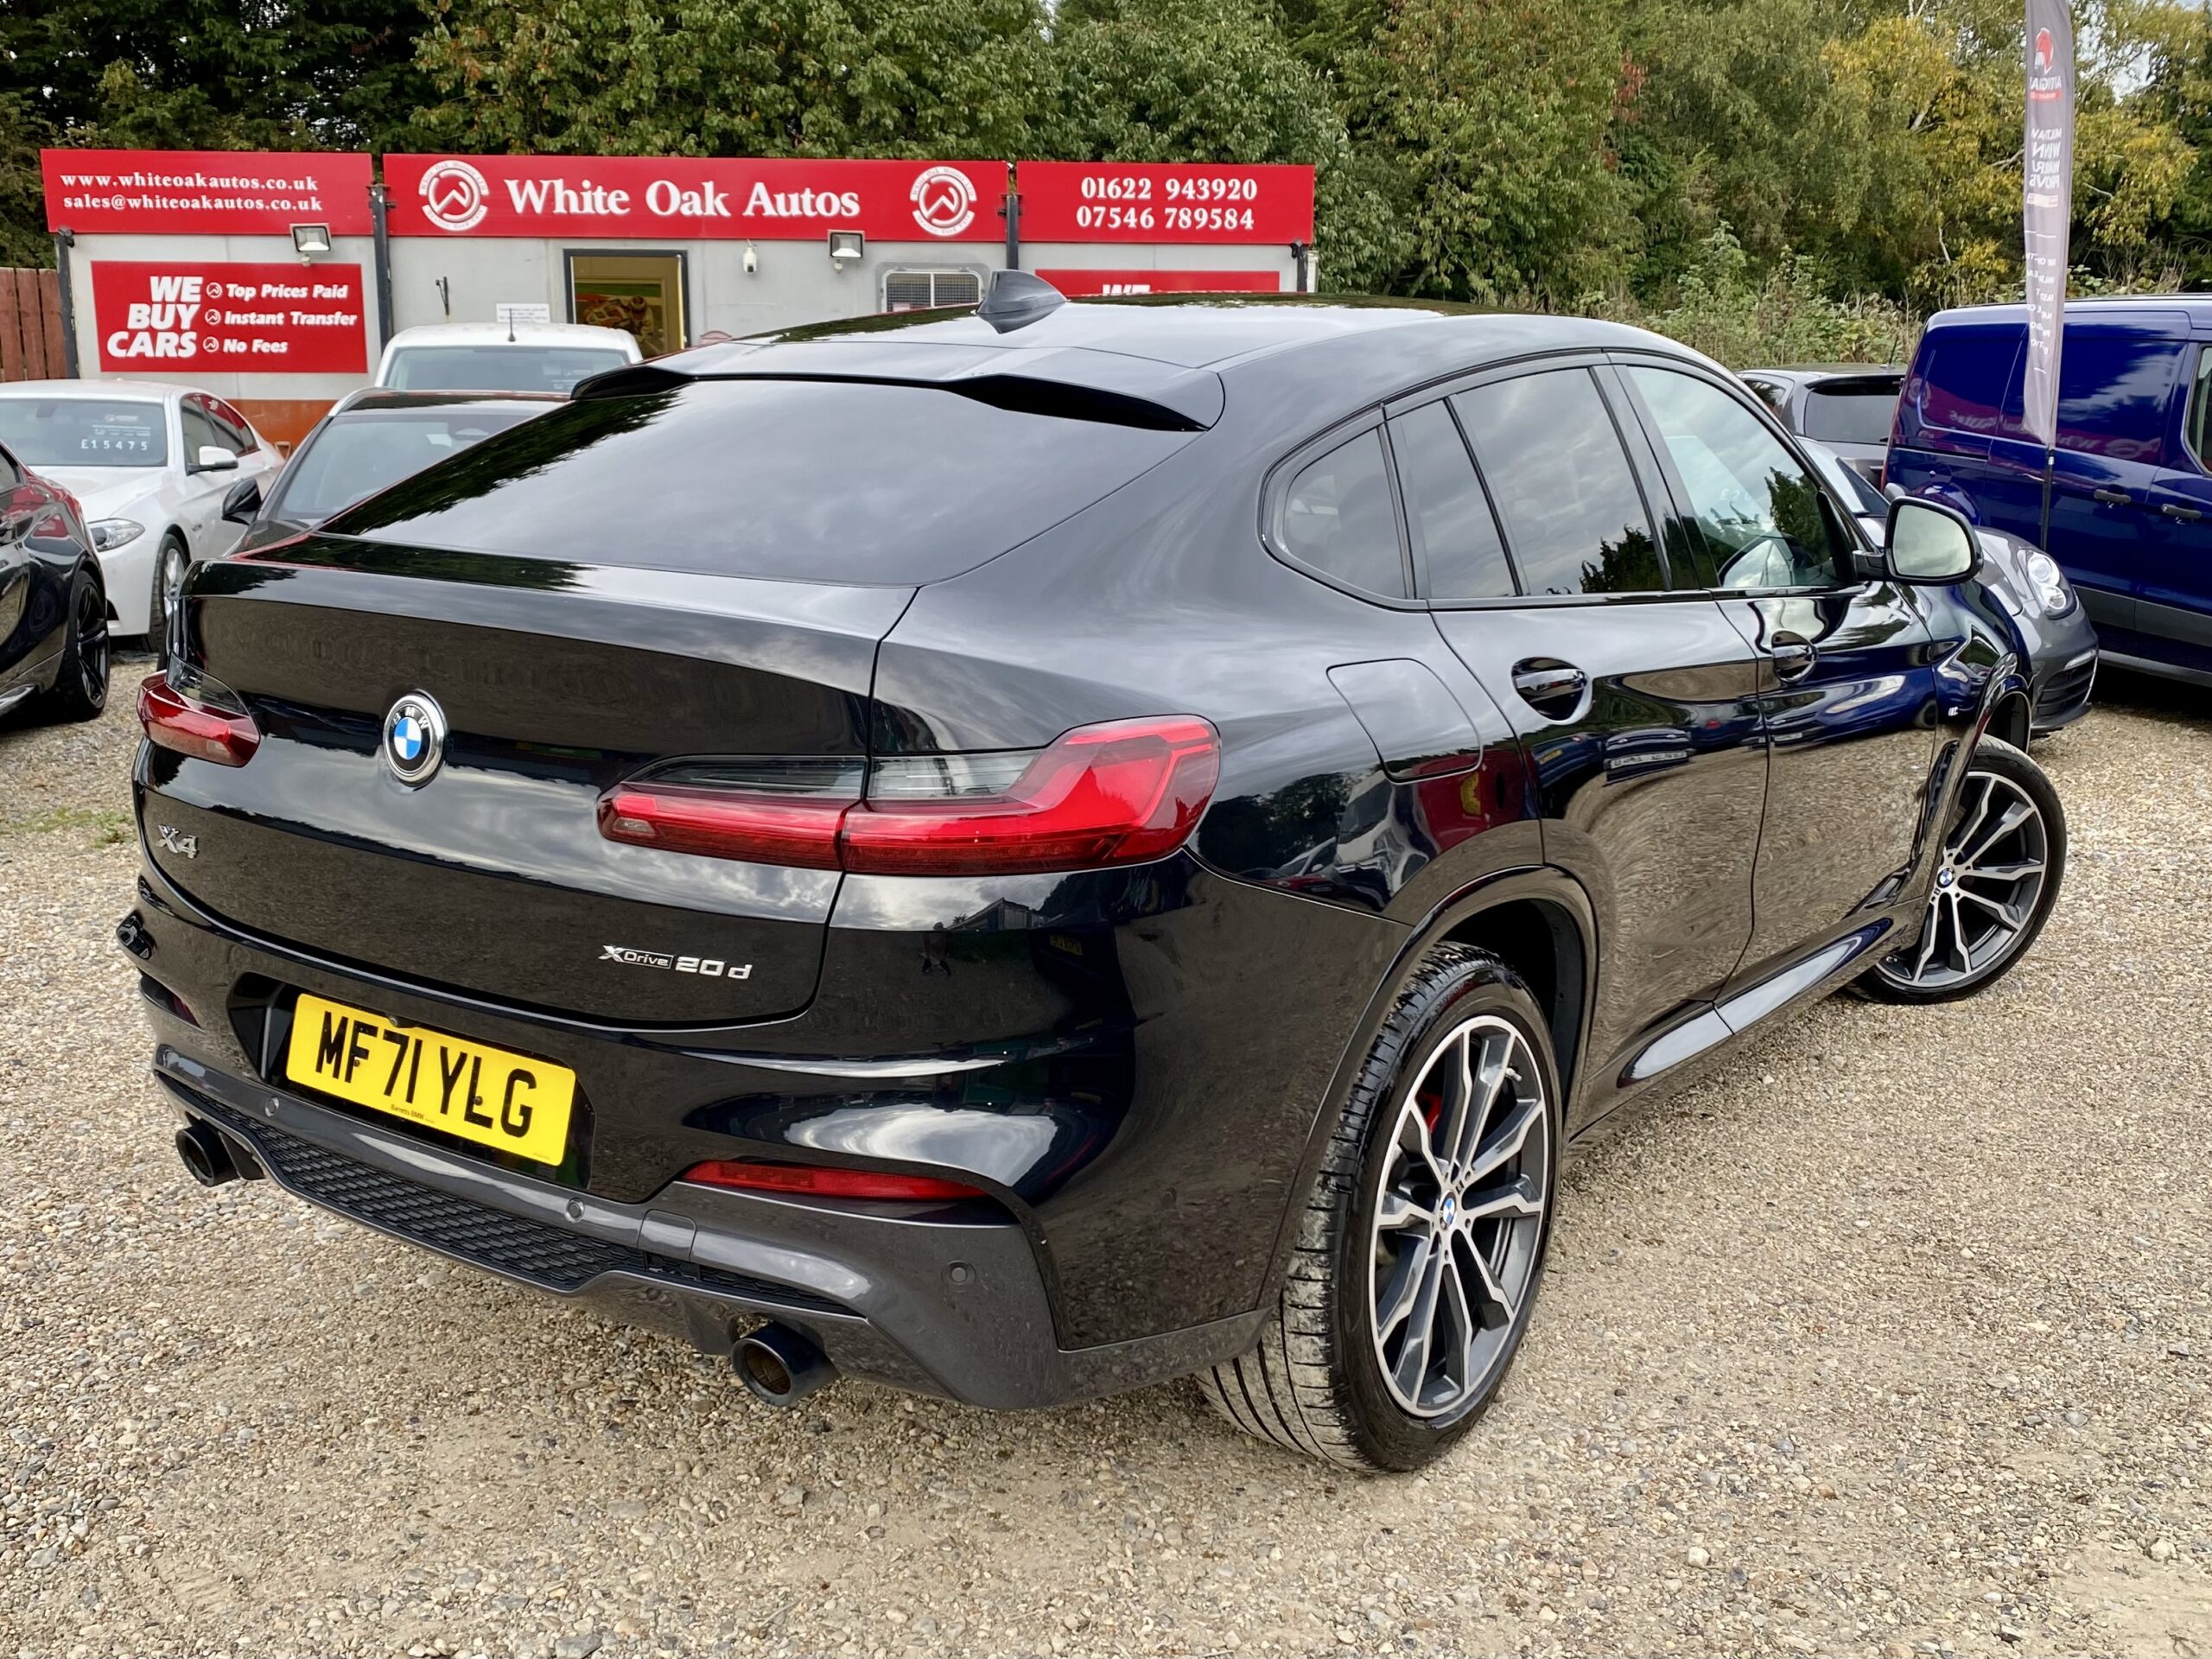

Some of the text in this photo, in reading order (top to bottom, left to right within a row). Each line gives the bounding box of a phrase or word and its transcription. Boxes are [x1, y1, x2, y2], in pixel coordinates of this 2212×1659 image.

[60, 172, 318, 191] www.whiteoakautos.co.uk
[1081, 177, 1258, 200] 01622 943920
[63, 194, 323, 212] sales@whiteoakautos.co.uk
[504, 178, 861, 218] White Oak Autos
[1076, 206, 1254, 230] 07546 789584
[149, 276, 203, 302] WE
[226, 283, 348, 302] Top Prices Paid
[127, 303, 201, 329] BUY
[224, 311, 358, 326] Instant Transfer
[106, 331, 198, 358] CARS
[223, 338, 289, 353] No Fees
[393, 706, 429, 730] BMW
[156, 824, 198, 859] X4
[315, 1010, 537, 1139] MF71 YLG
